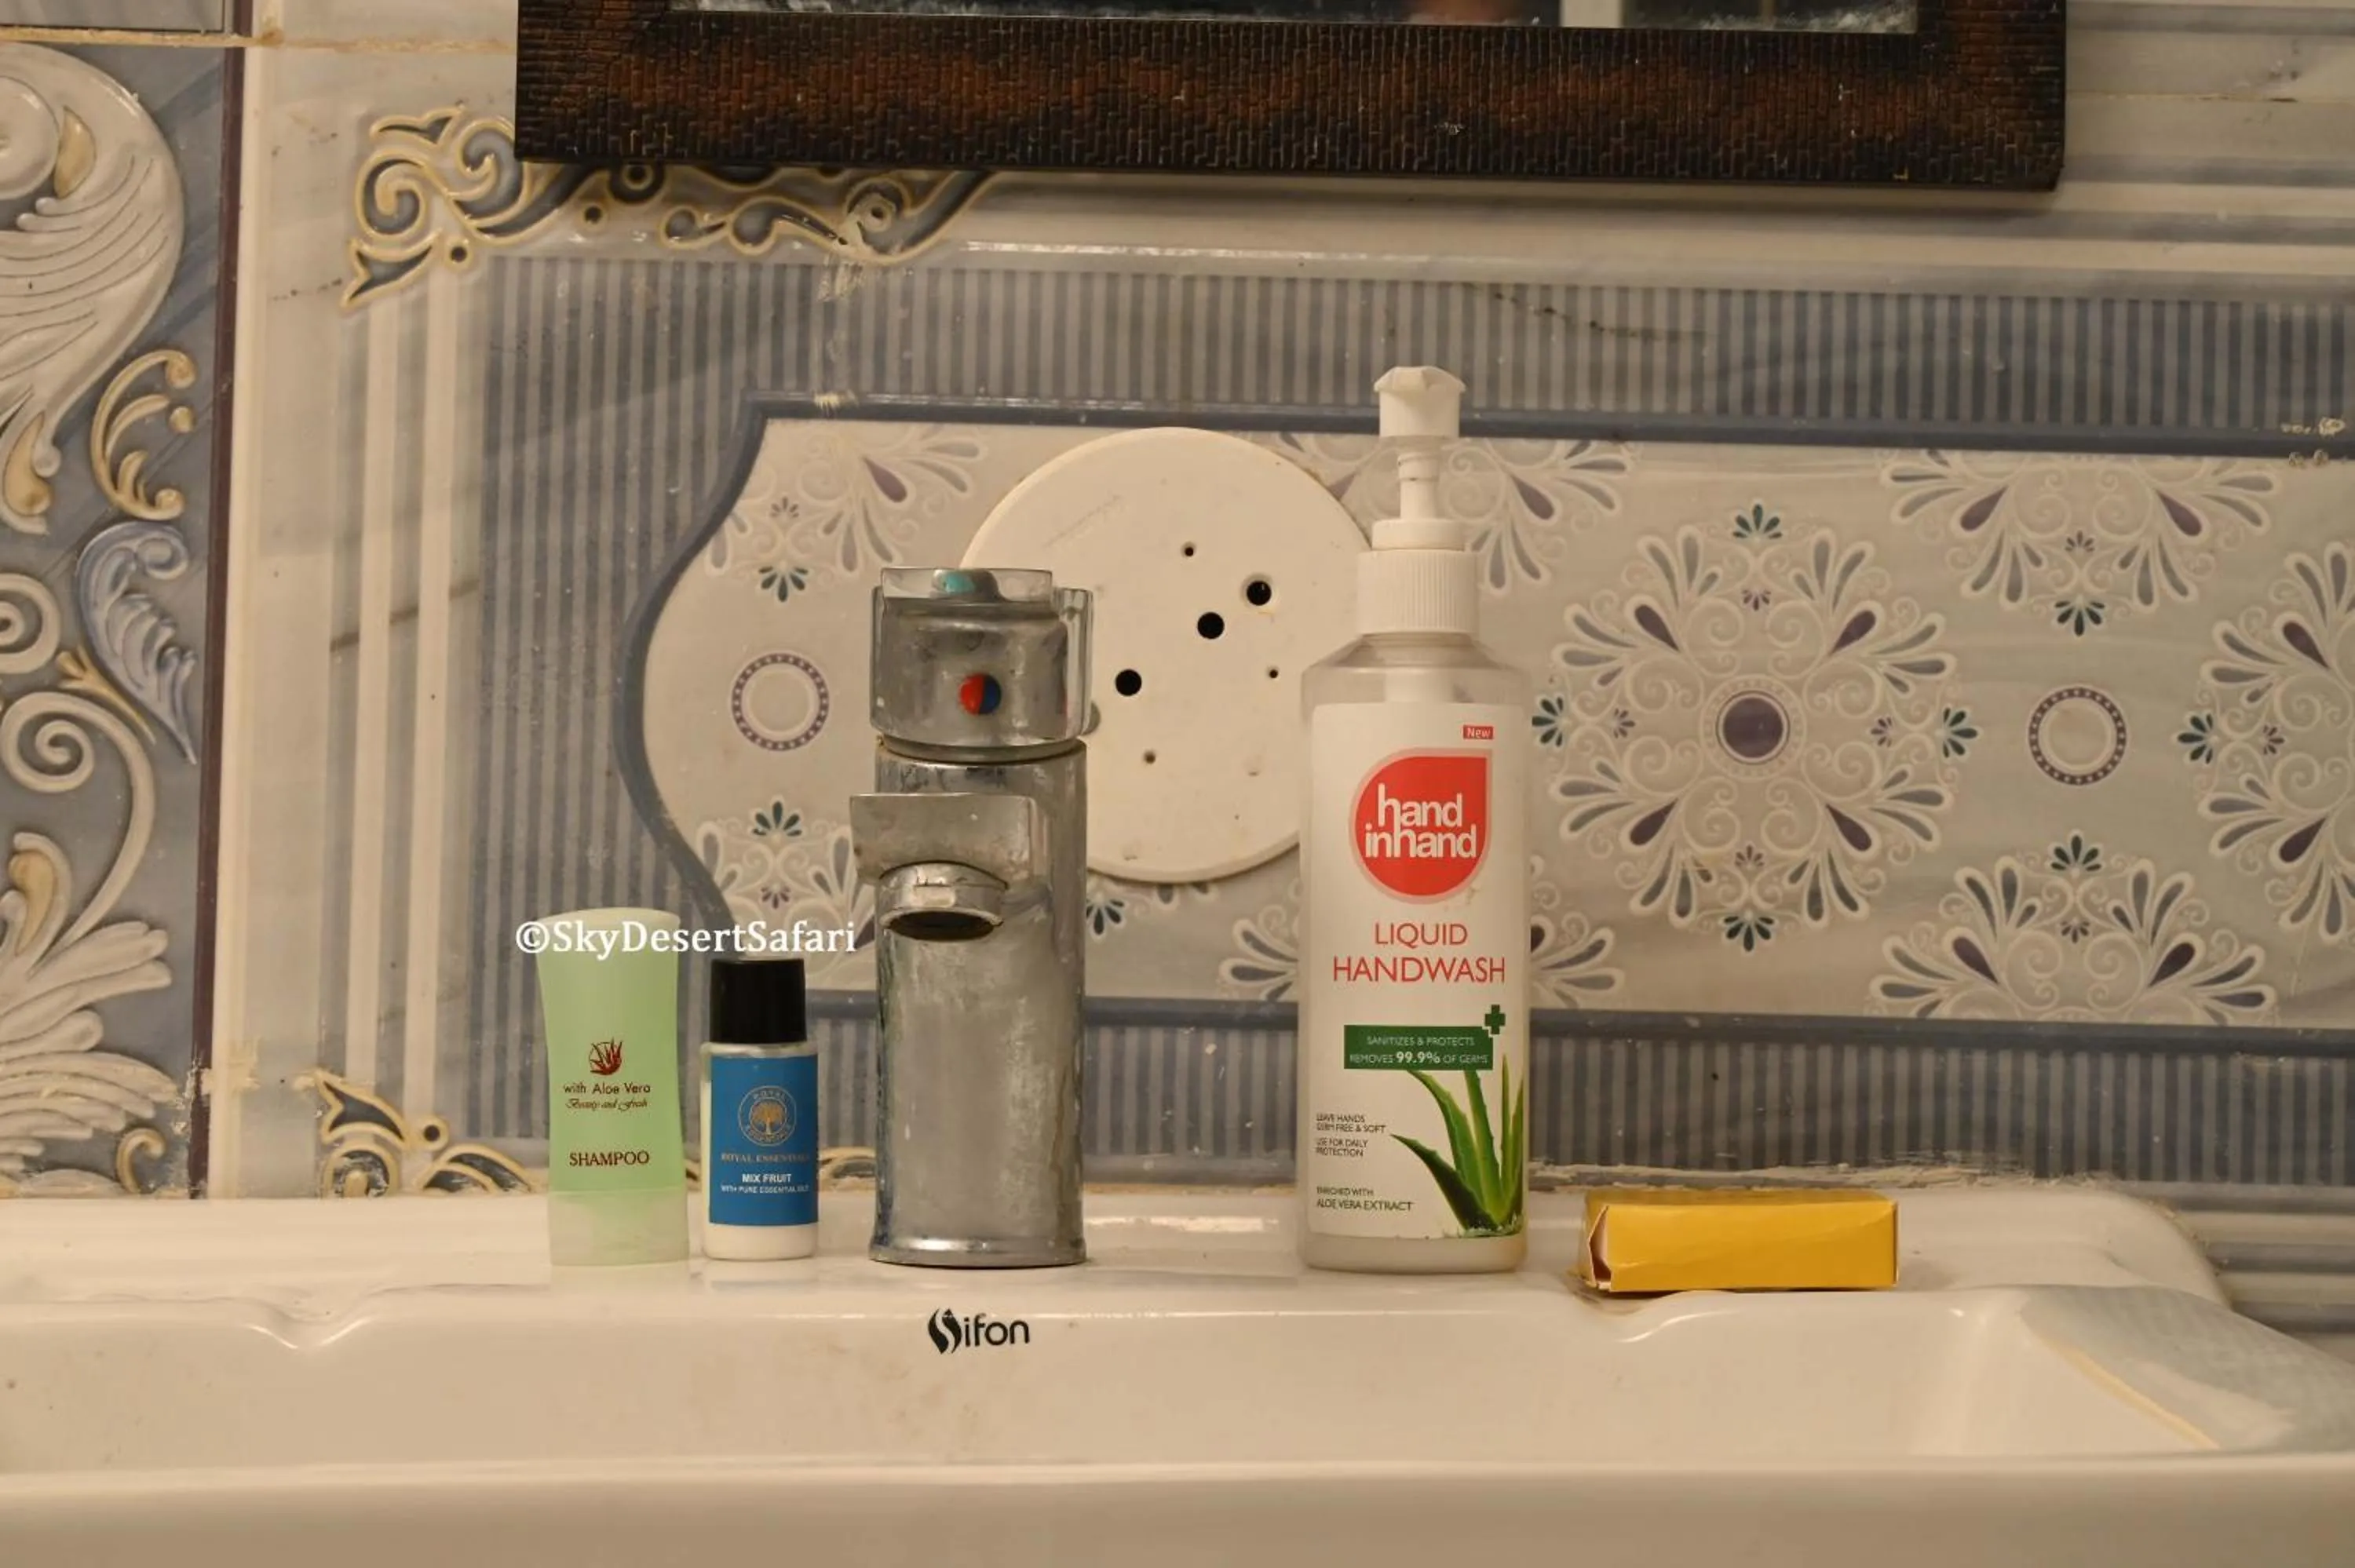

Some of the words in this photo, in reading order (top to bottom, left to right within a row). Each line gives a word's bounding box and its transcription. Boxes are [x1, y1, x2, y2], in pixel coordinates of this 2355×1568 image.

[1466, 727, 1491, 738] New
[1378, 782, 1462, 827] hand
[1375, 922, 1469, 950] LIQUID
[1333, 955, 1506, 983] HANDWASH
[1367, 1036, 1413, 1047] SANITIZES
[1416, 1037, 1423, 1047] &
[1426, 1037, 1475, 1047] PROTECTS
[1349, 1053, 1393, 1064] REMOVES
[1396, 1050, 1440, 1064] 99.9%
[1443, 1054, 1456, 1064] OF
[1459, 1055, 1489, 1064] GERMS
[563, 1081, 587, 1094] with
[592, 1081, 621, 1095] Aloe
[623, 1081, 651, 1094] Vera
[601, 1099, 618, 1109] and
[1337, 1114, 1366, 1123] HANDS
[1363, 1124, 1387, 1134] SOFT
[1345, 1139, 1369, 1149] DAILY
[1315, 1147, 1364, 1158] PROTECTION
[569, 1150, 650, 1167] SHAMPOO
[742, 1172, 761, 1183] MIX
[762, 1172, 792, 1184] FRUIT
[739, 1185, 758, 1194] PURE
[1351, 1187, 1375, 1197] WITH
[1316, 1198, 1337, 1209] ALOE
[1338, 1198, 1362, 1210] VERA
[1364, 1199, 1415, 1212] EXTRACT
